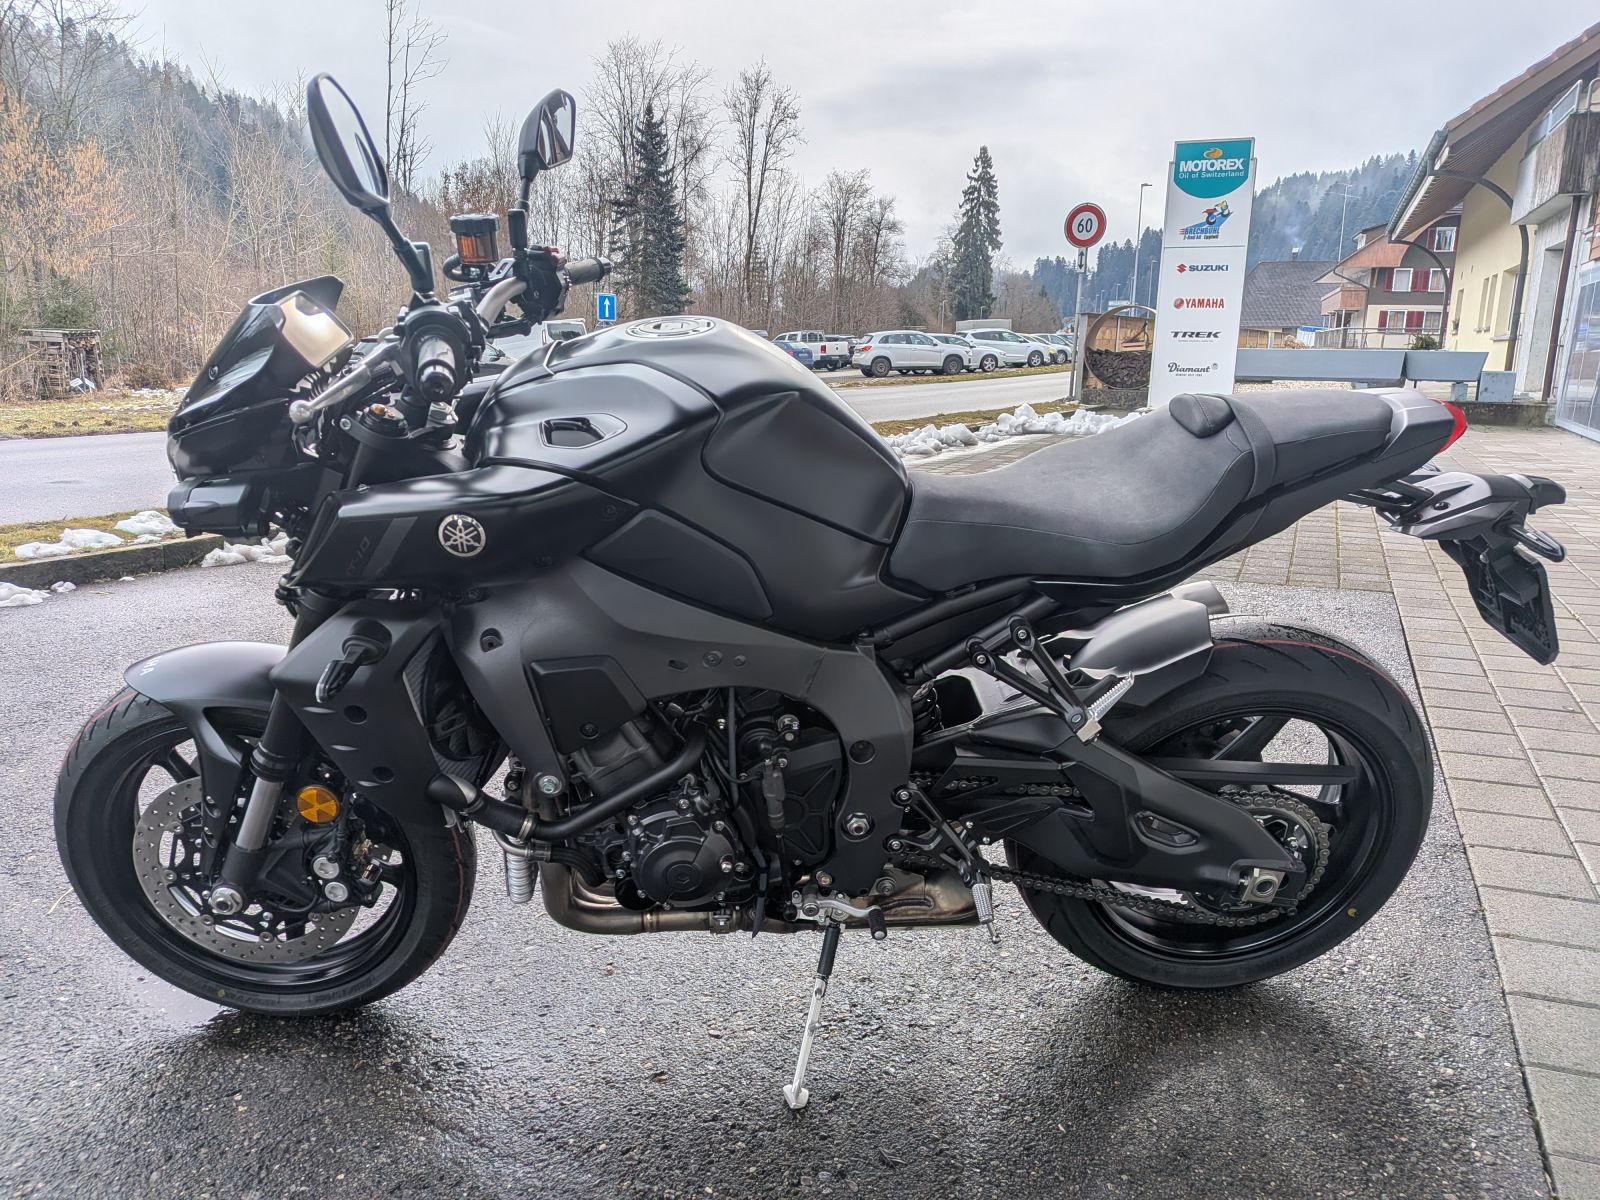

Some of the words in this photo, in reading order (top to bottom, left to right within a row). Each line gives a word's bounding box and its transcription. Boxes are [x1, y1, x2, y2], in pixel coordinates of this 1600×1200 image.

[1180, 158, 1244, 172] MOTOREX
[1077, 218, 1093, 233] 60
[1188, 264, 1229, 272] SUZUKI
[1185, 298, 1225, 309] YAMAHA
[1168, 362, 1211, 373] Diamant
